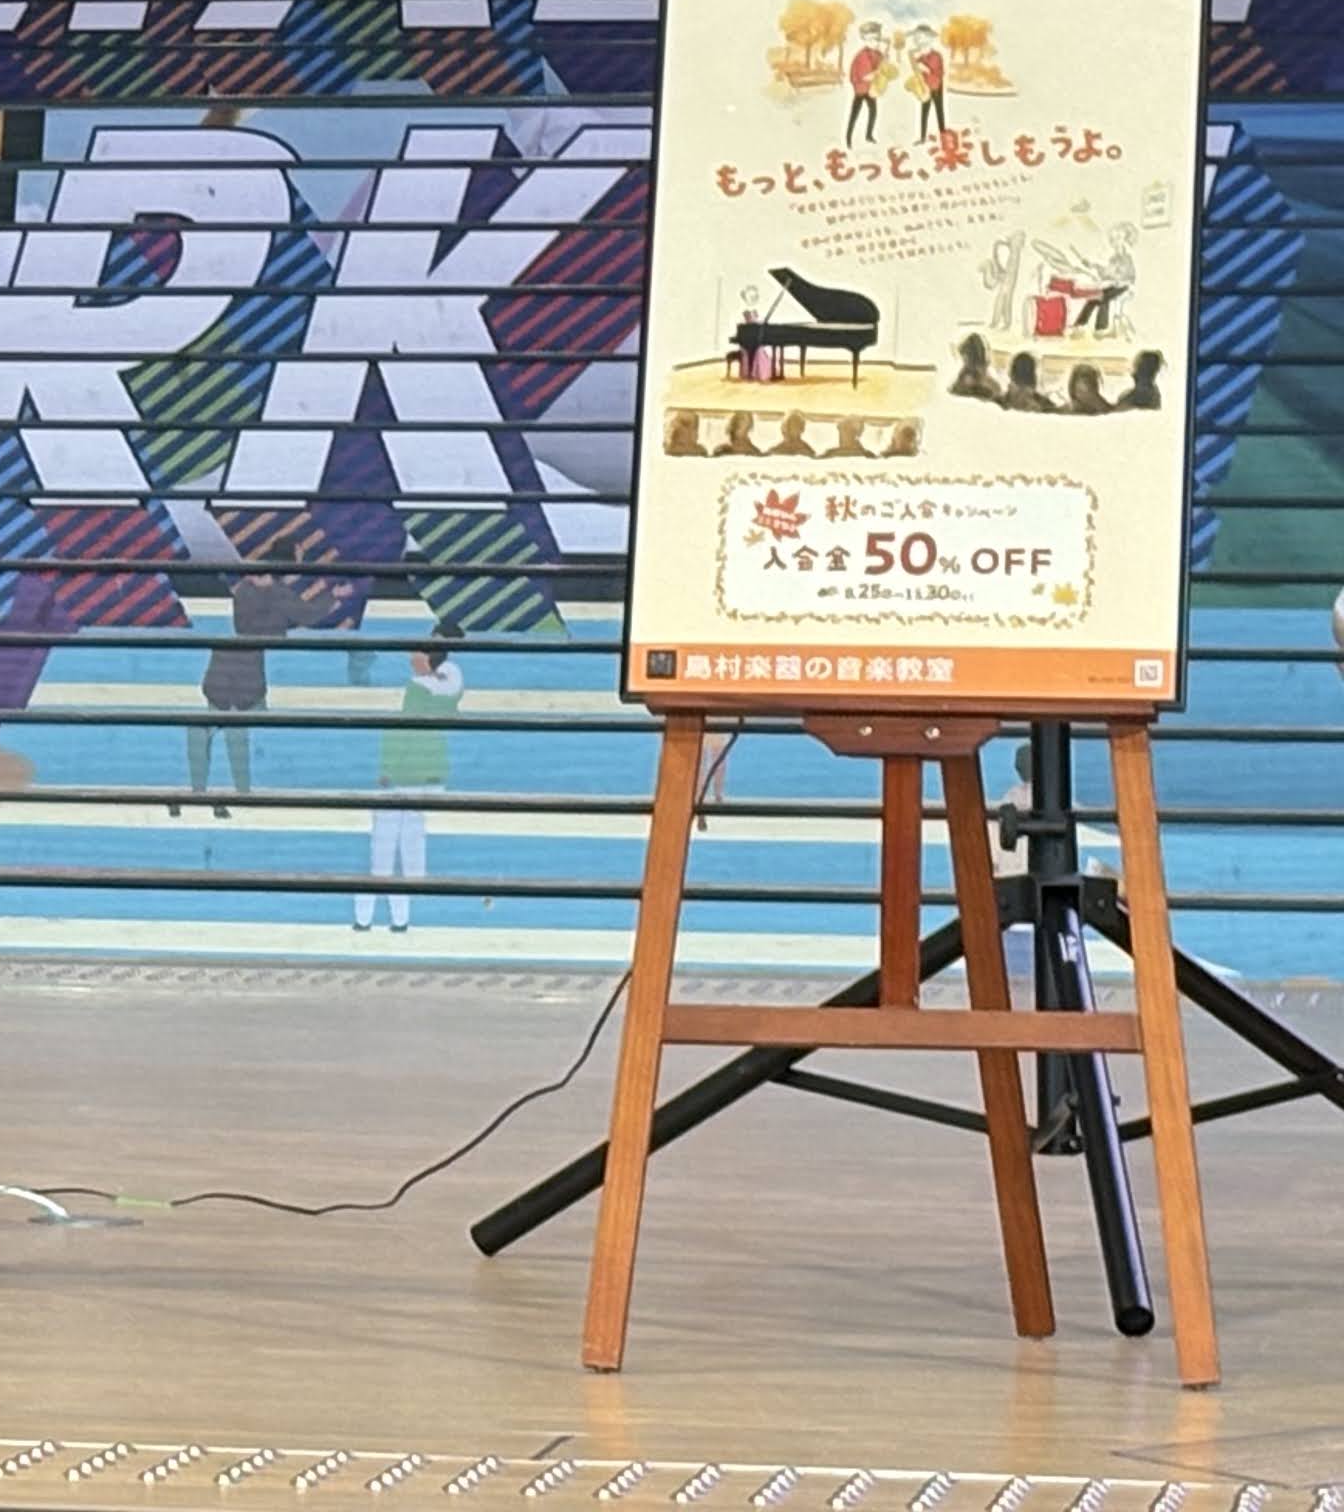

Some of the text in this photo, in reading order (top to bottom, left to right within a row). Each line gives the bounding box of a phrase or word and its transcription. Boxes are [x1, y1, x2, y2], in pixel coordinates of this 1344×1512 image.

[716, 126, 1122, 197] もっと、もっと、楽しもうよ。
[970, 547, 1052, 576] OFF
[684, 654, 954, 683] 島村楽器の音楽教室
